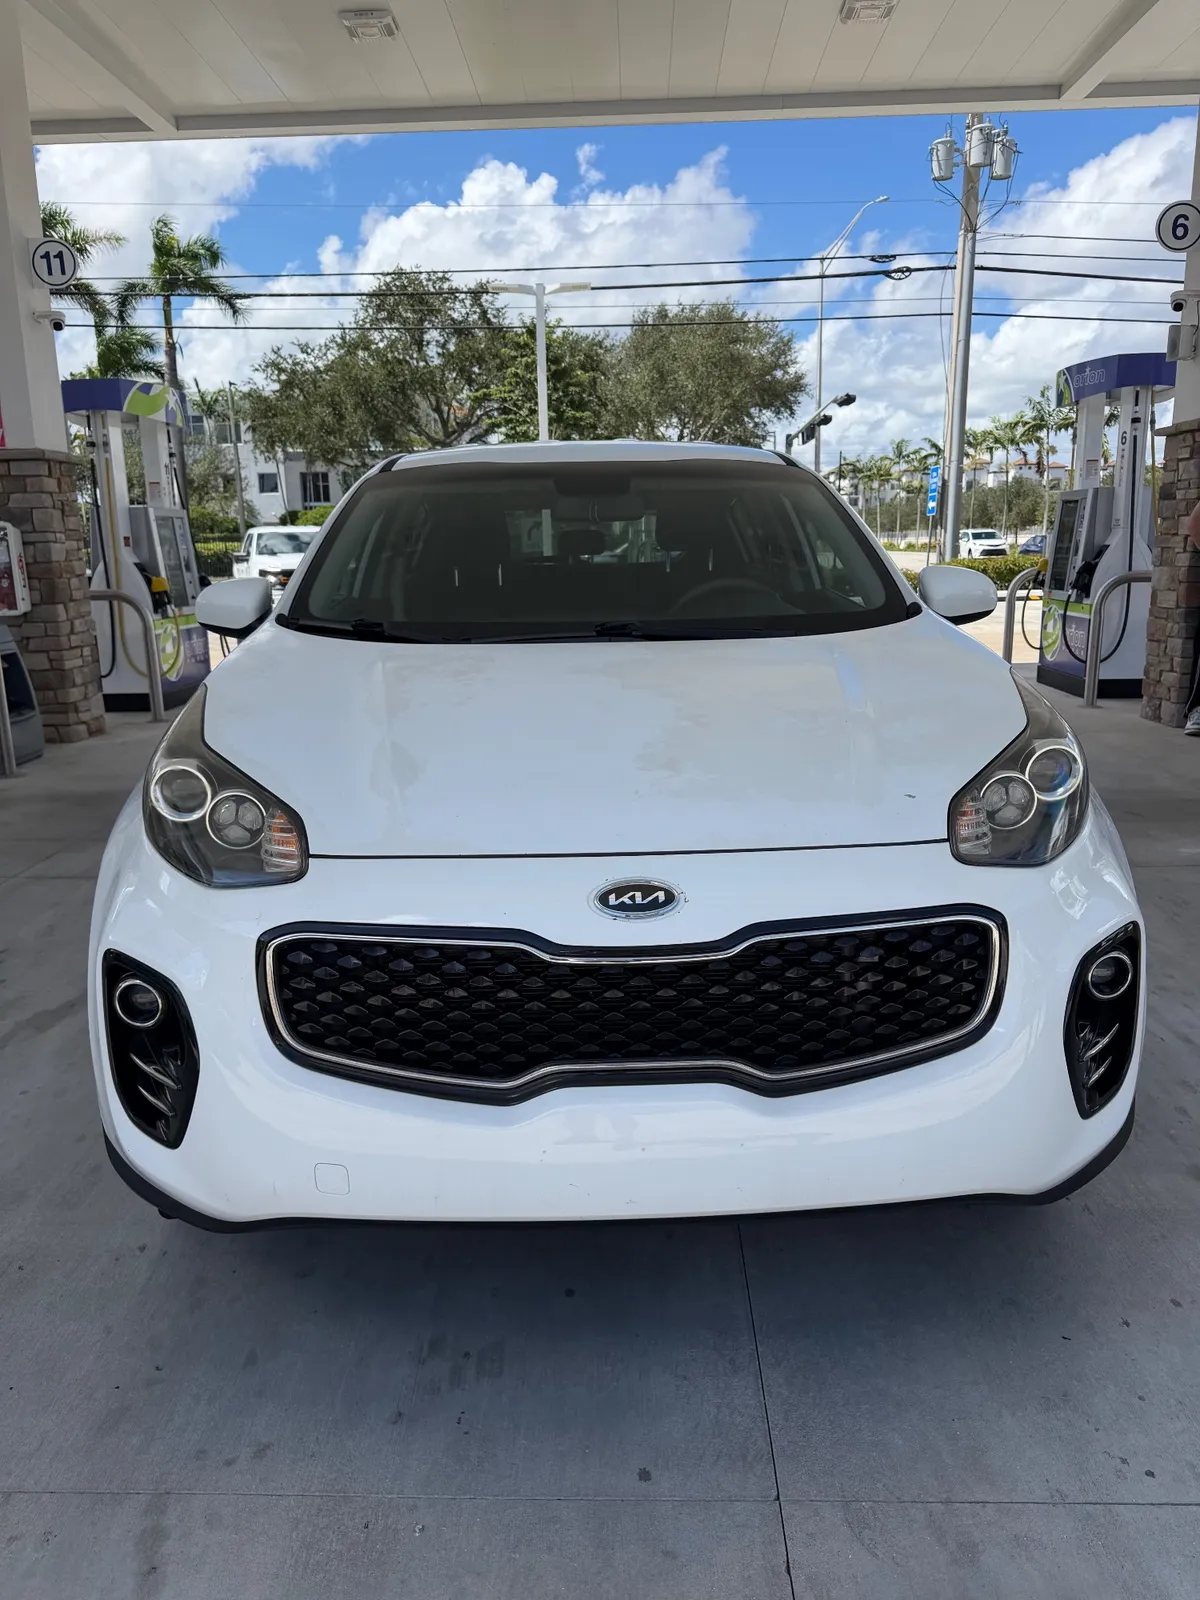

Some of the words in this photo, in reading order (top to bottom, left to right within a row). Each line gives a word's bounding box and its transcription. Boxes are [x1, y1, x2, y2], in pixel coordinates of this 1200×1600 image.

[1171, 213, 1190, 241] 6
[40, 250, 66, 276] 11
[1073, 366, 1106, 388] orion
[1120, 430, 1128, 446] 6
[608, 890, 666, 906] KIA
